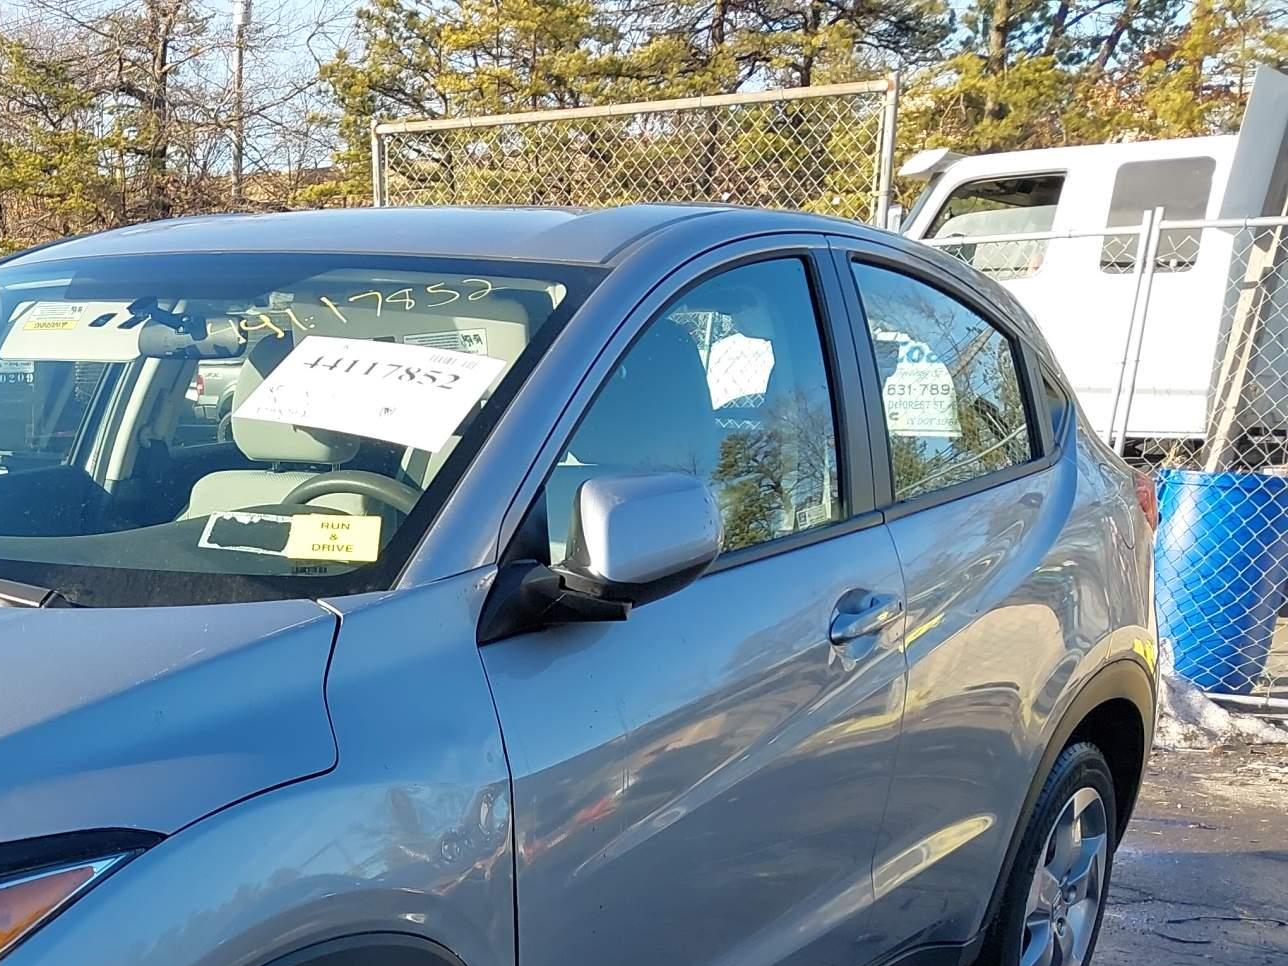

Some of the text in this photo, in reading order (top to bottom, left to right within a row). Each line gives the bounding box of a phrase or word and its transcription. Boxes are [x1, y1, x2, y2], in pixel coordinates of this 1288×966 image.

[303, 354, 462, 390] 44117852
[320, 522, 351, 530] RUN
[311, 543, 353, 553] DRIVE
